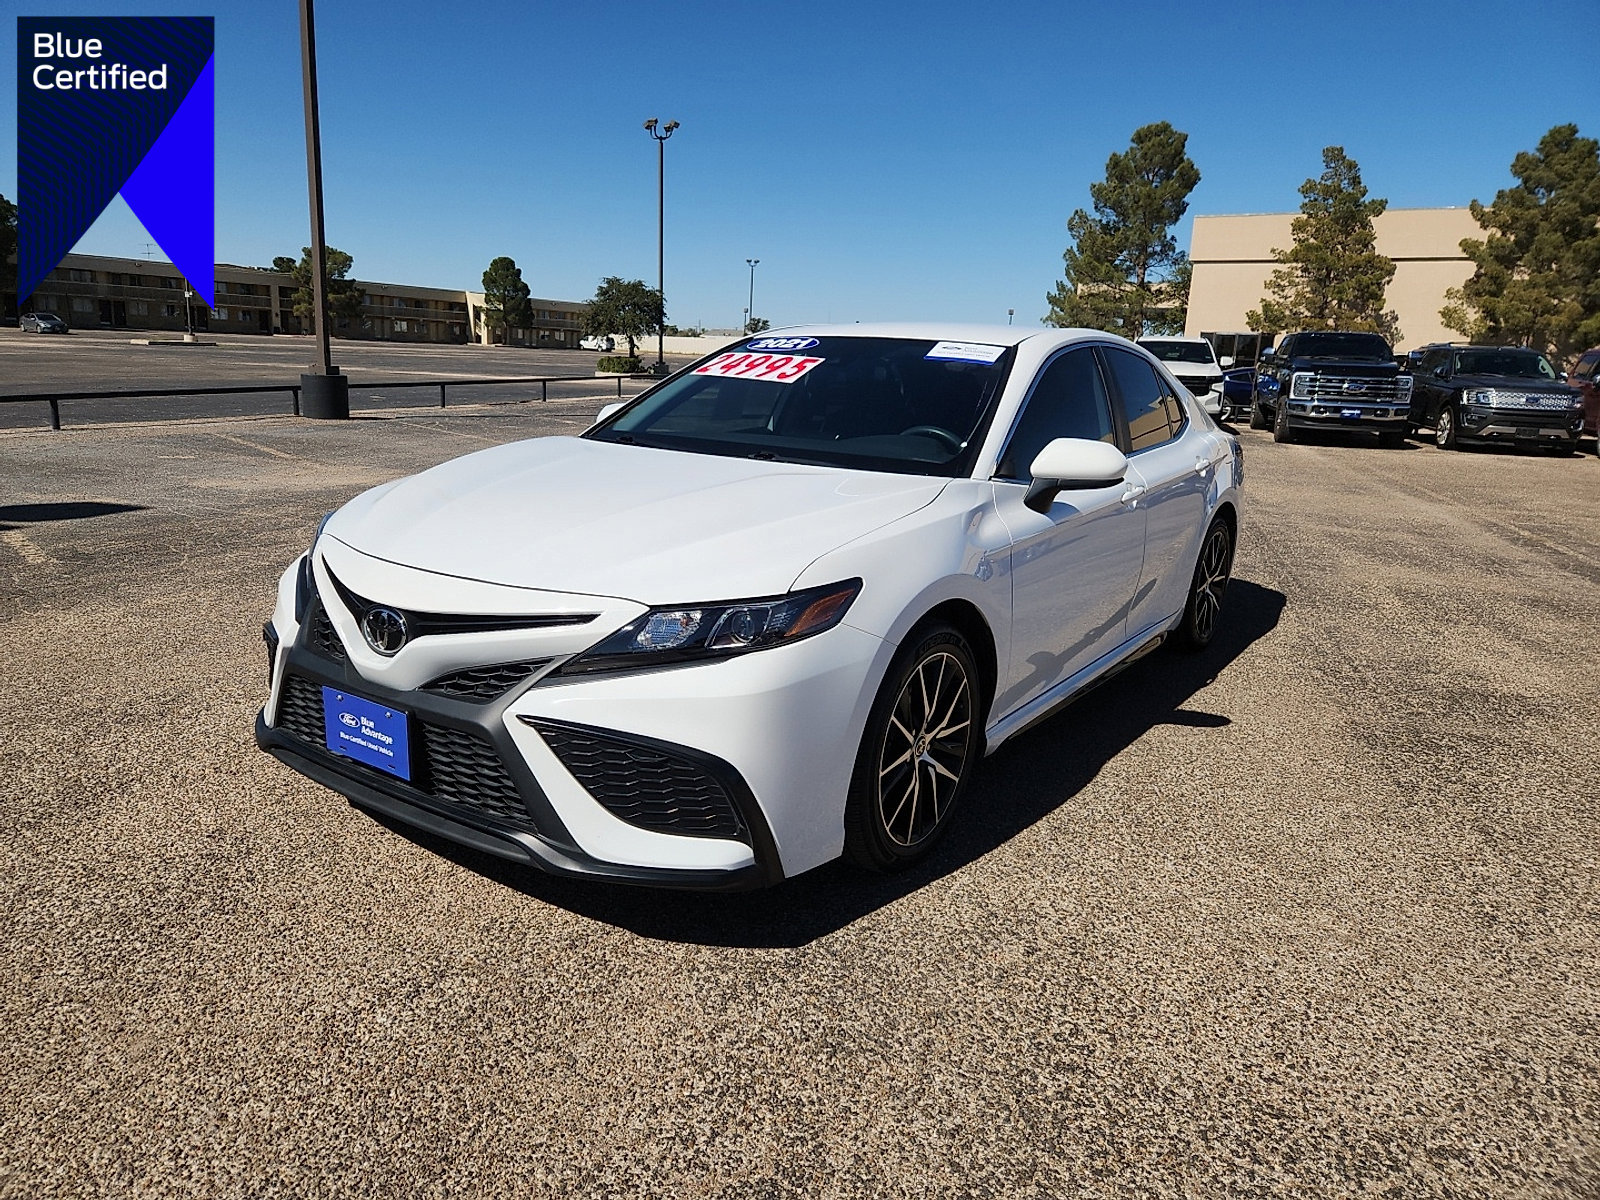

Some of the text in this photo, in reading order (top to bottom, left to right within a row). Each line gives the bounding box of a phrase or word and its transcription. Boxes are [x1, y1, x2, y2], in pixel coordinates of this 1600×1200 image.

[754, 338, 809, 349] 2021
[695, 353, 821, 380] 24995
[361, 716, 375, 728] Blue
[361, 725, 393, 745] Advantage
